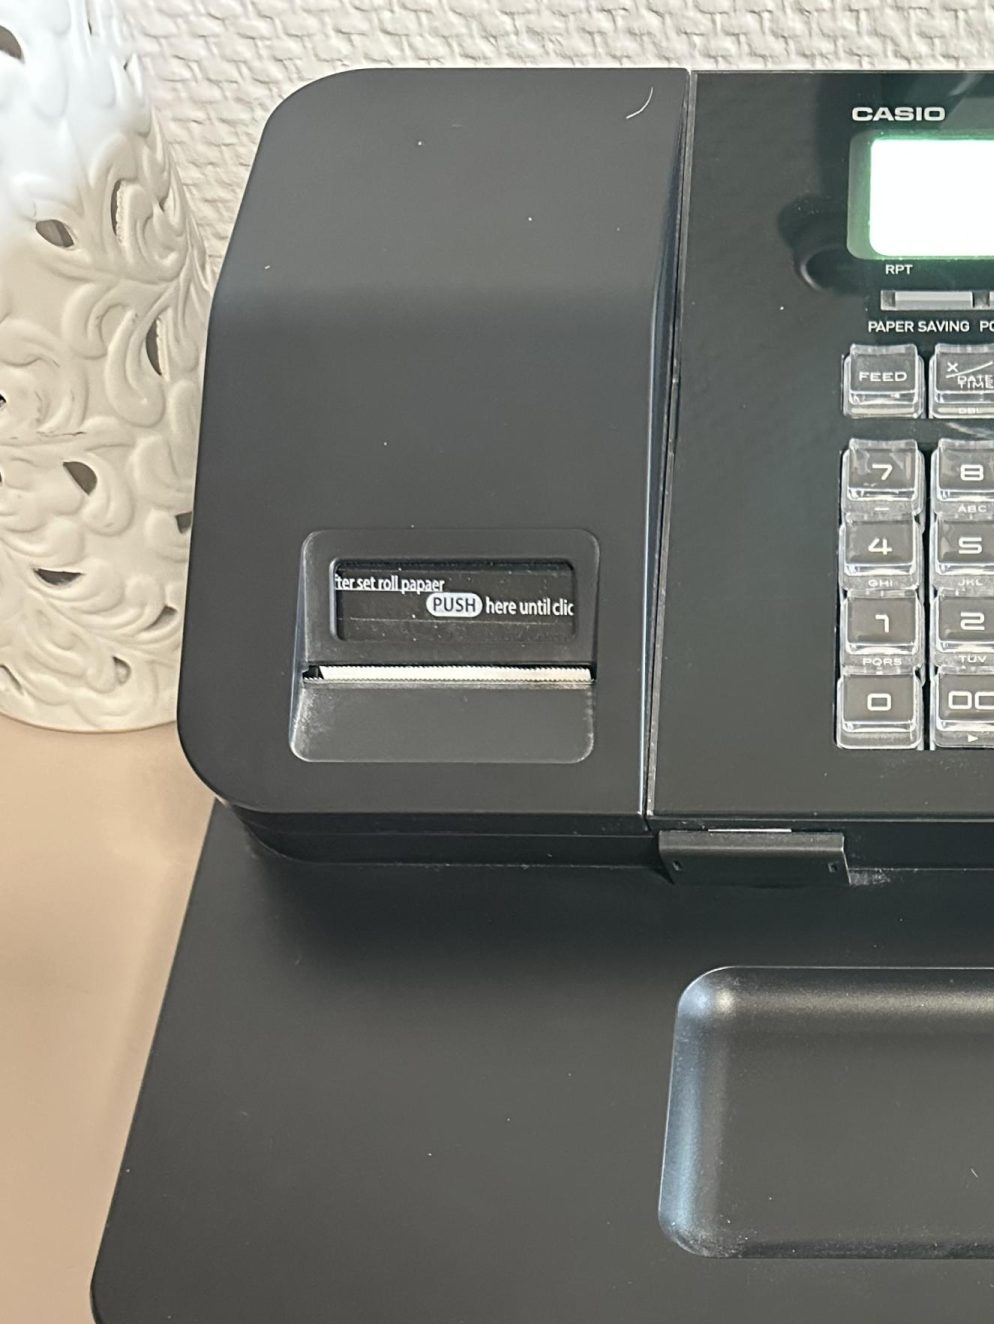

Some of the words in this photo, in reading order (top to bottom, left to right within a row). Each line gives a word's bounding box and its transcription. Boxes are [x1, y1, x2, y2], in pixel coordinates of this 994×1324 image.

[852, 107, 945, 122] CASIO
[885, 264, 913, 275] RPT
[868, 321, 914, 333] PAPER
[918, 321, 970, 333] SAVING
[859, 371, 908, 382] FEED
[957, 375, 993, 384] DATE
[872, 464, 893, 480] 7
[960, 464, 984, 481] 8
[868, 538, 893, 555] 4
[958, 537, 982, 554] 5
[357, 576, 376, 591] set
[377, 575, 399, 591] roll
[401, 579, 445, 595] papaer
[868, 579, 893, 587] GHI
[958, 578, 984, 586] JKL
[433, 597, 476, 612] PUSH
[486, 597, 517, 615] here
[520, 598, 551, 615] until
[552, 598, 575, 616] clic
[875, 614, 890, 632] 1
[960, 612, 985, 631] 2
[863, 657, 902, 667] PQRS
[959, 655, 986, 663] TUV
